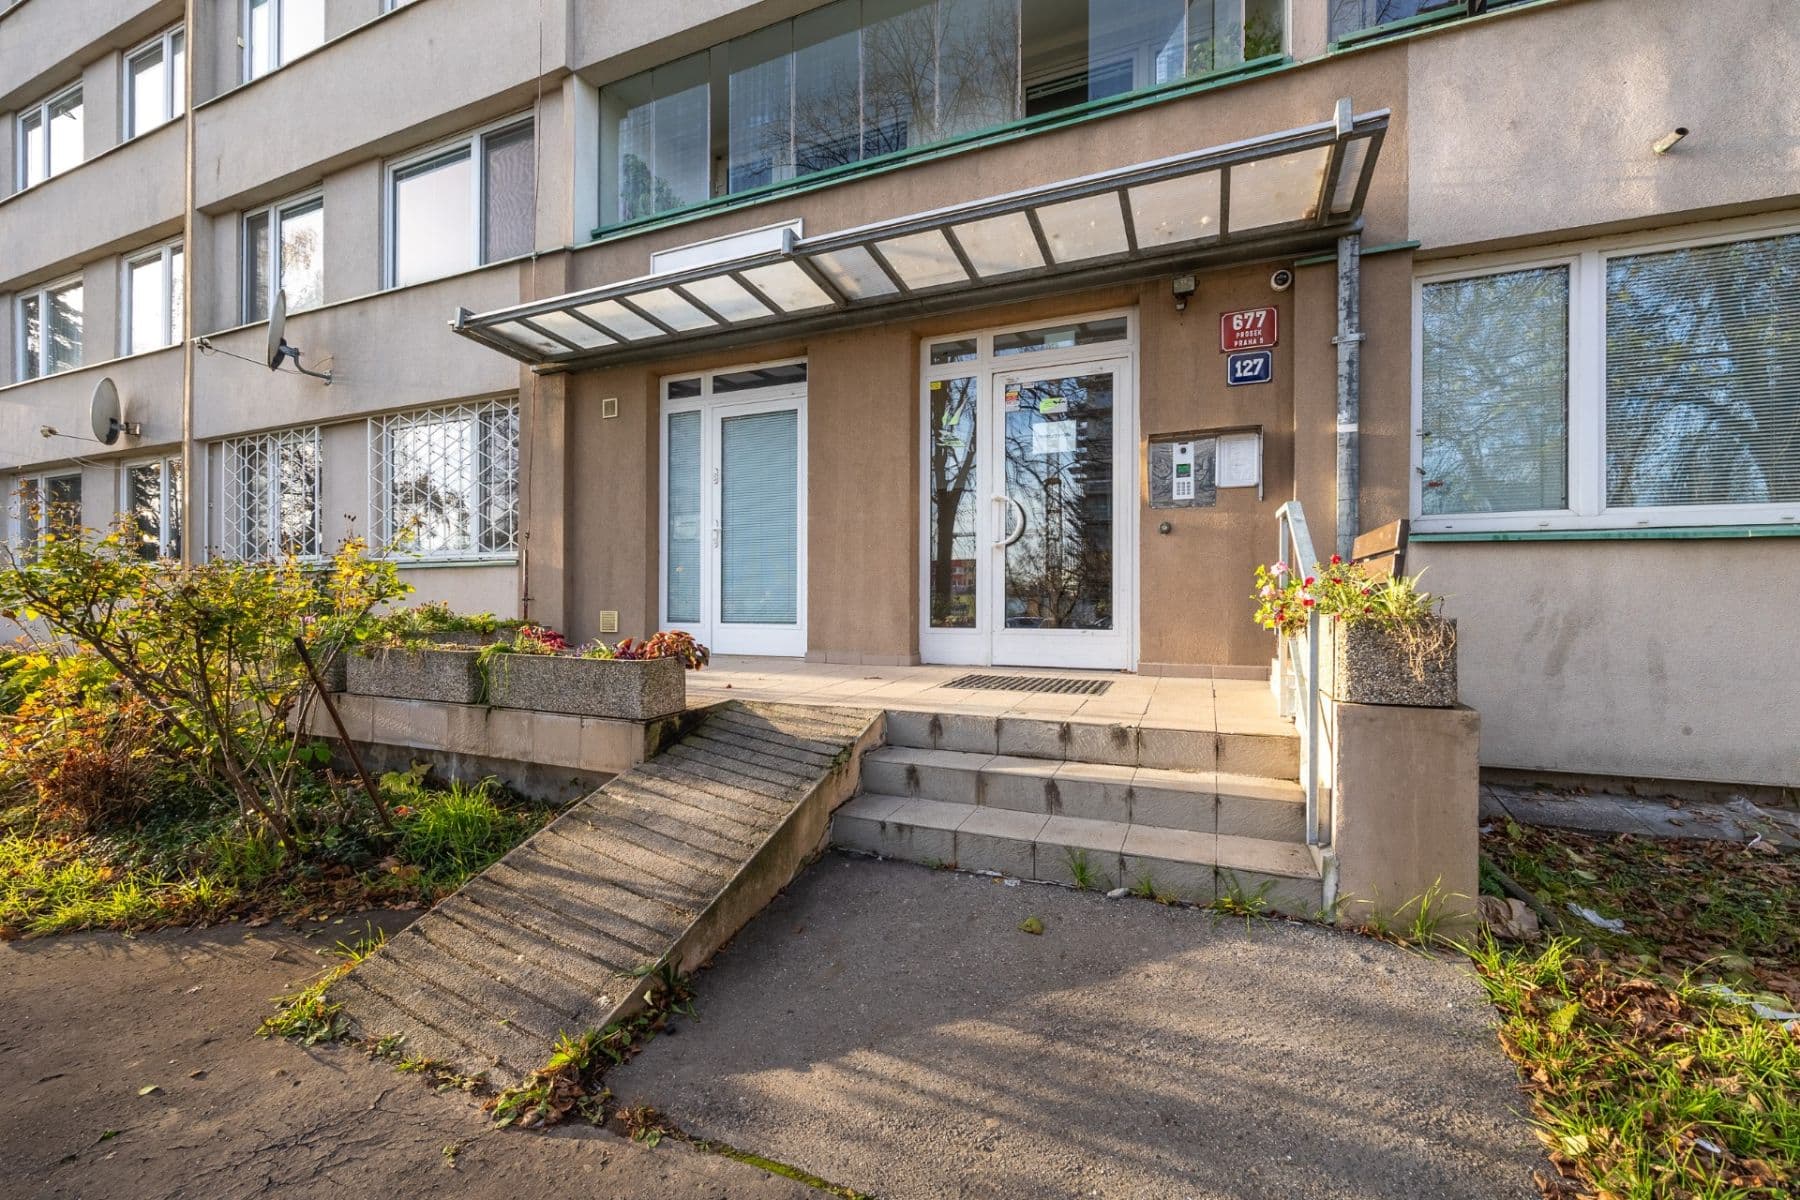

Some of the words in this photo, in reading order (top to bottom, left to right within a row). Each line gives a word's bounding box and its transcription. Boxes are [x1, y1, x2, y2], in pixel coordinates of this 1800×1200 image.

[1232, 310, 1267, 330] 677
[1236, 329, 1262, 338] PROSEK
[1234, 338, 1257, 347] PRAHA
[1235, 358, 1264, 377] 127
